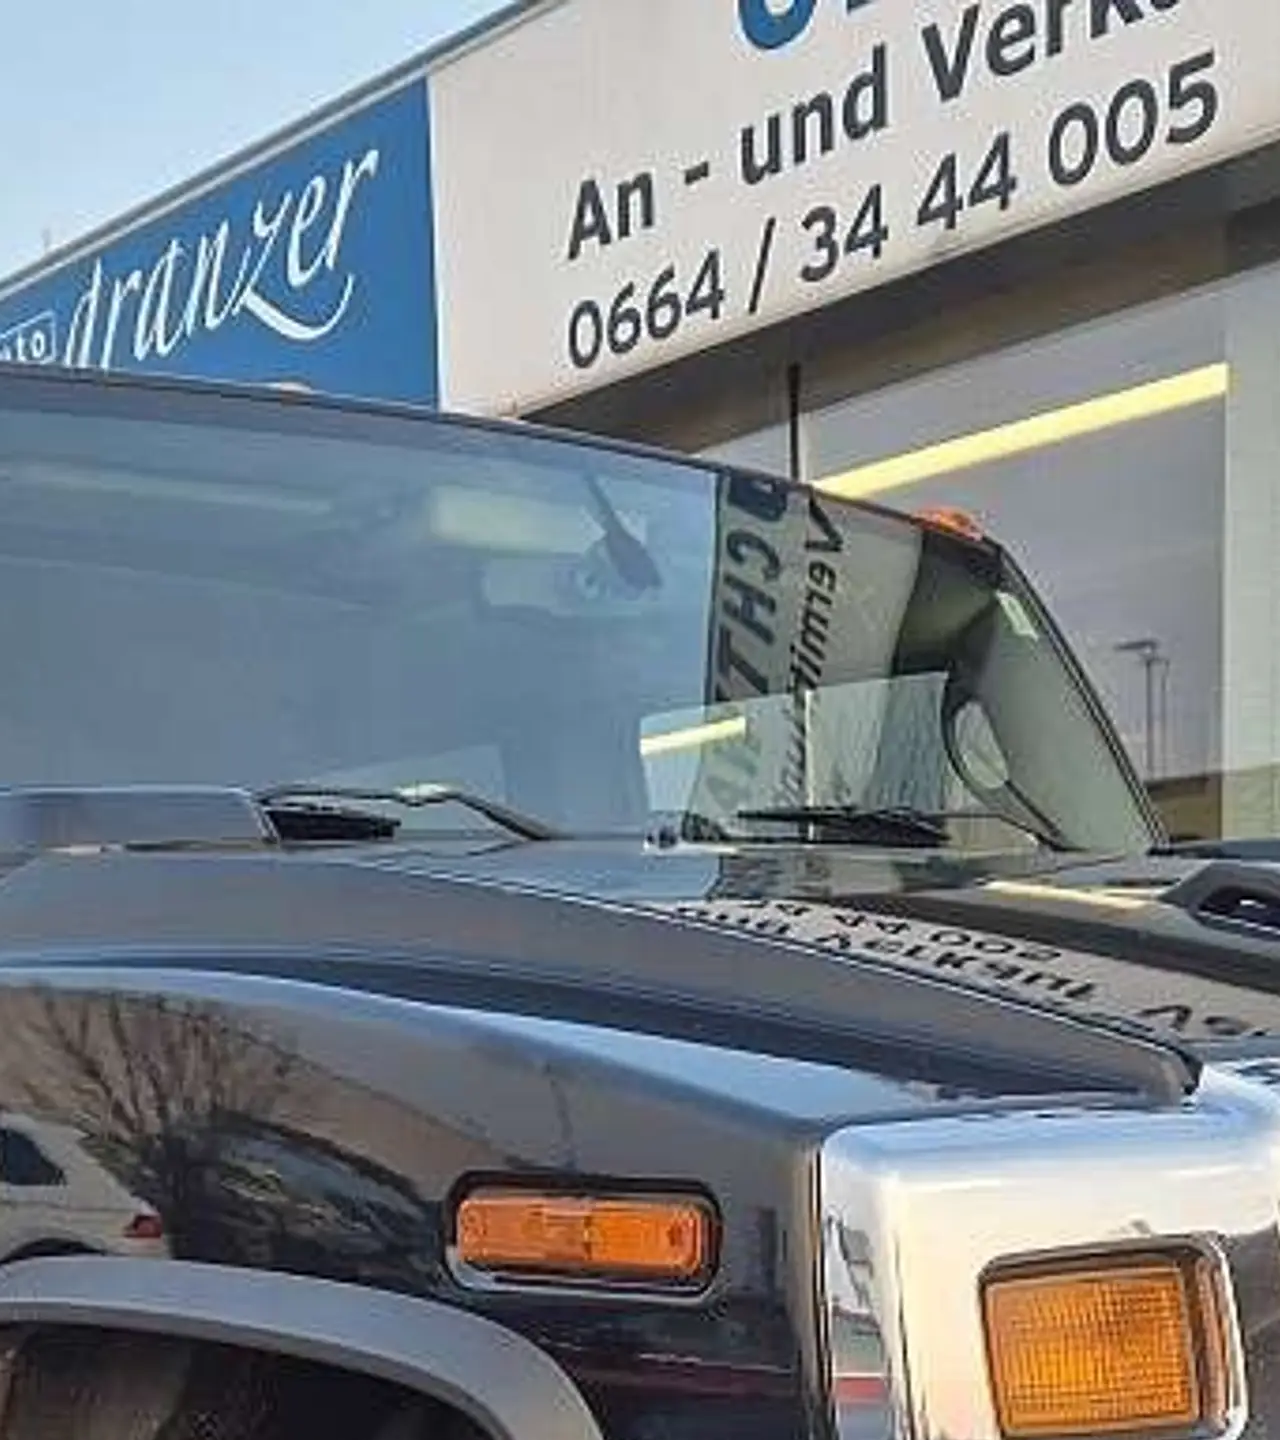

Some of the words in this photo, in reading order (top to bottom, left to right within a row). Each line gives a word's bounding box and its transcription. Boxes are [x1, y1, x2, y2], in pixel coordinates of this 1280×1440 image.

[568, 178, 653, 260] An
[740, 42, 888, 185] und
[569, 248, 724, 369] 0664
[800, 184, 888, 282] 34
[917, 131, 1017, 230] 44
[1047, 48, 1219, 186] 005
